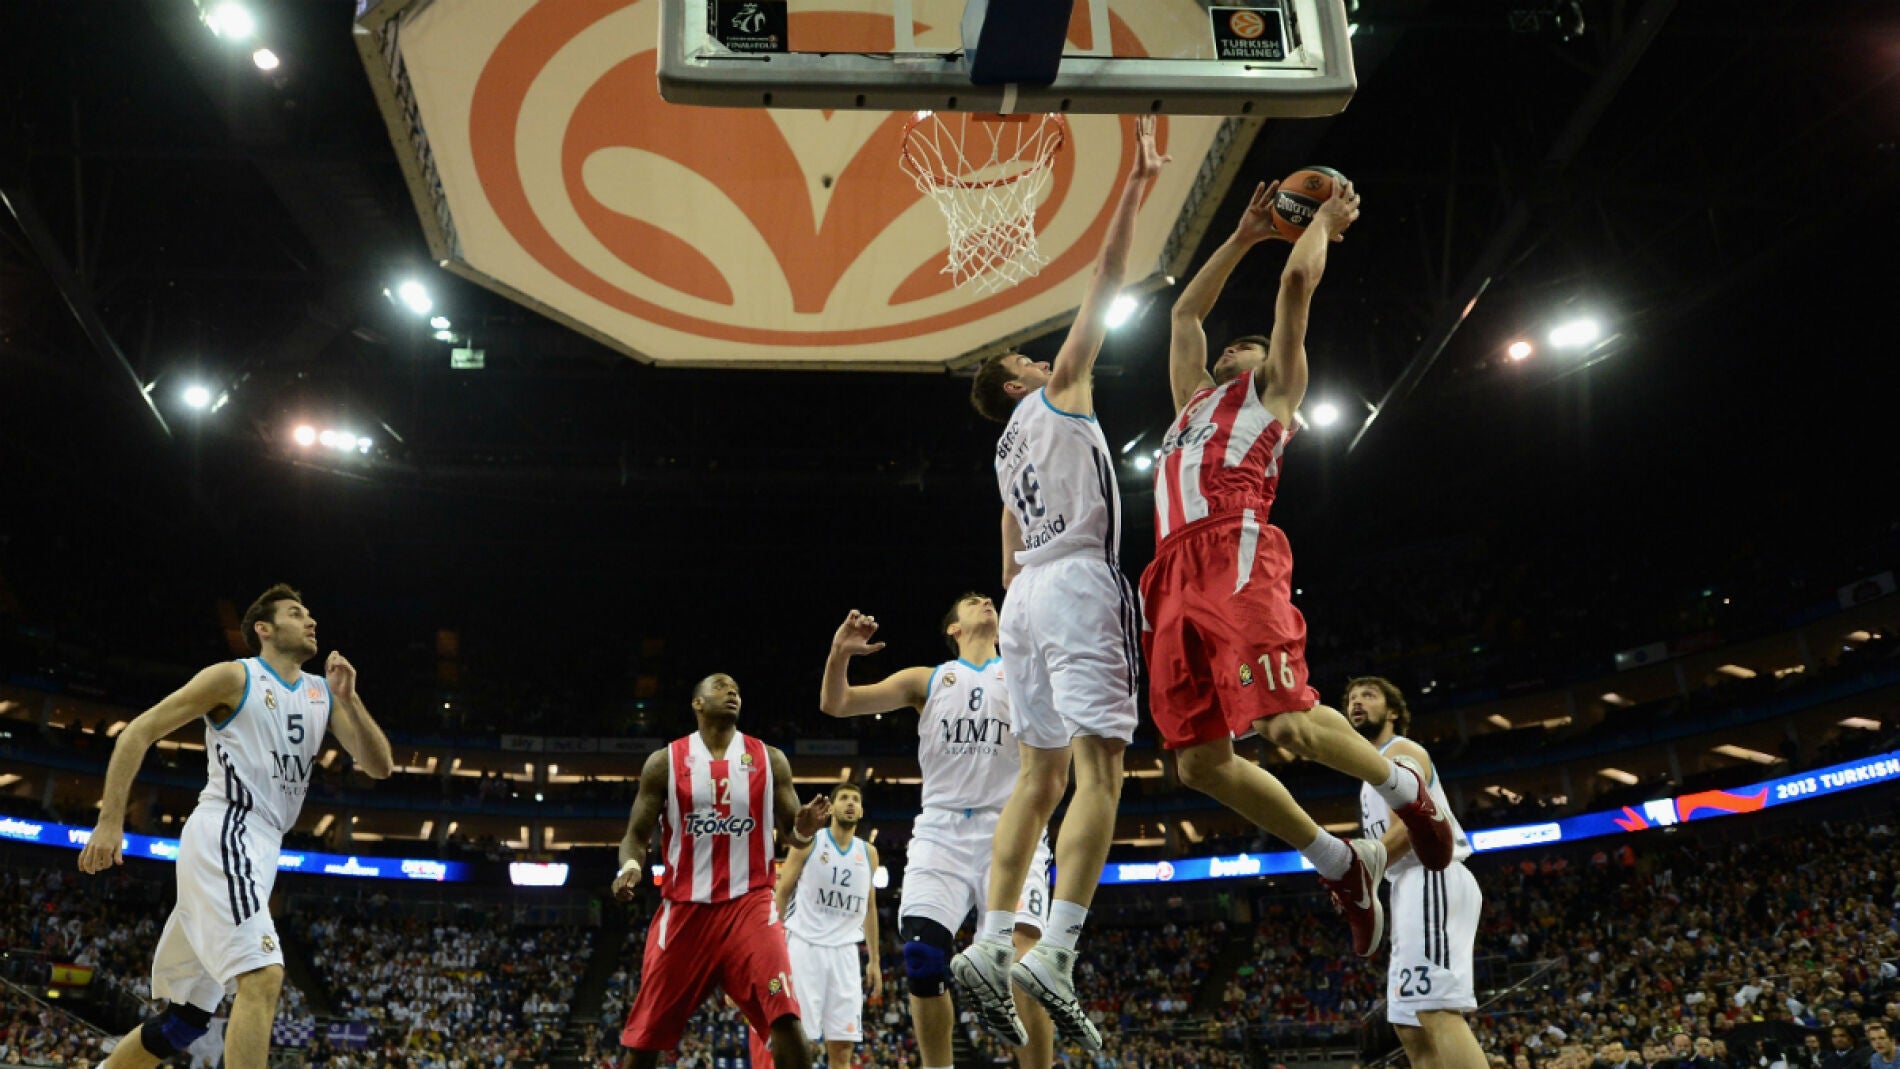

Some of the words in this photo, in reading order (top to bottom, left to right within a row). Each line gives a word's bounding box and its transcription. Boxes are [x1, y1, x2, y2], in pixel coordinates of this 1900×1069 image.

[1221, 39, 1280, 48] TURKISH
[1222, 48, 1281, 58] AIRLINES
[1258, 651, 1295, 691] 16
[969, 687, 984, 711] 8
[287, 713, 304, 744] 5
[941, 718, 1010, 746] MMT
[708, 778, 731, 805] 12
[1776, 777, 1817, 799] 2013
[1819, 758, 1900, 789] TURKISH
[832, 866, 852, 887] 12
[816, 887, 865, 912] MMT
[1028, 889, 1043, 917] 8
[779, 971, 793, 998] 1
[1399, 965, 1432, 996] 23
